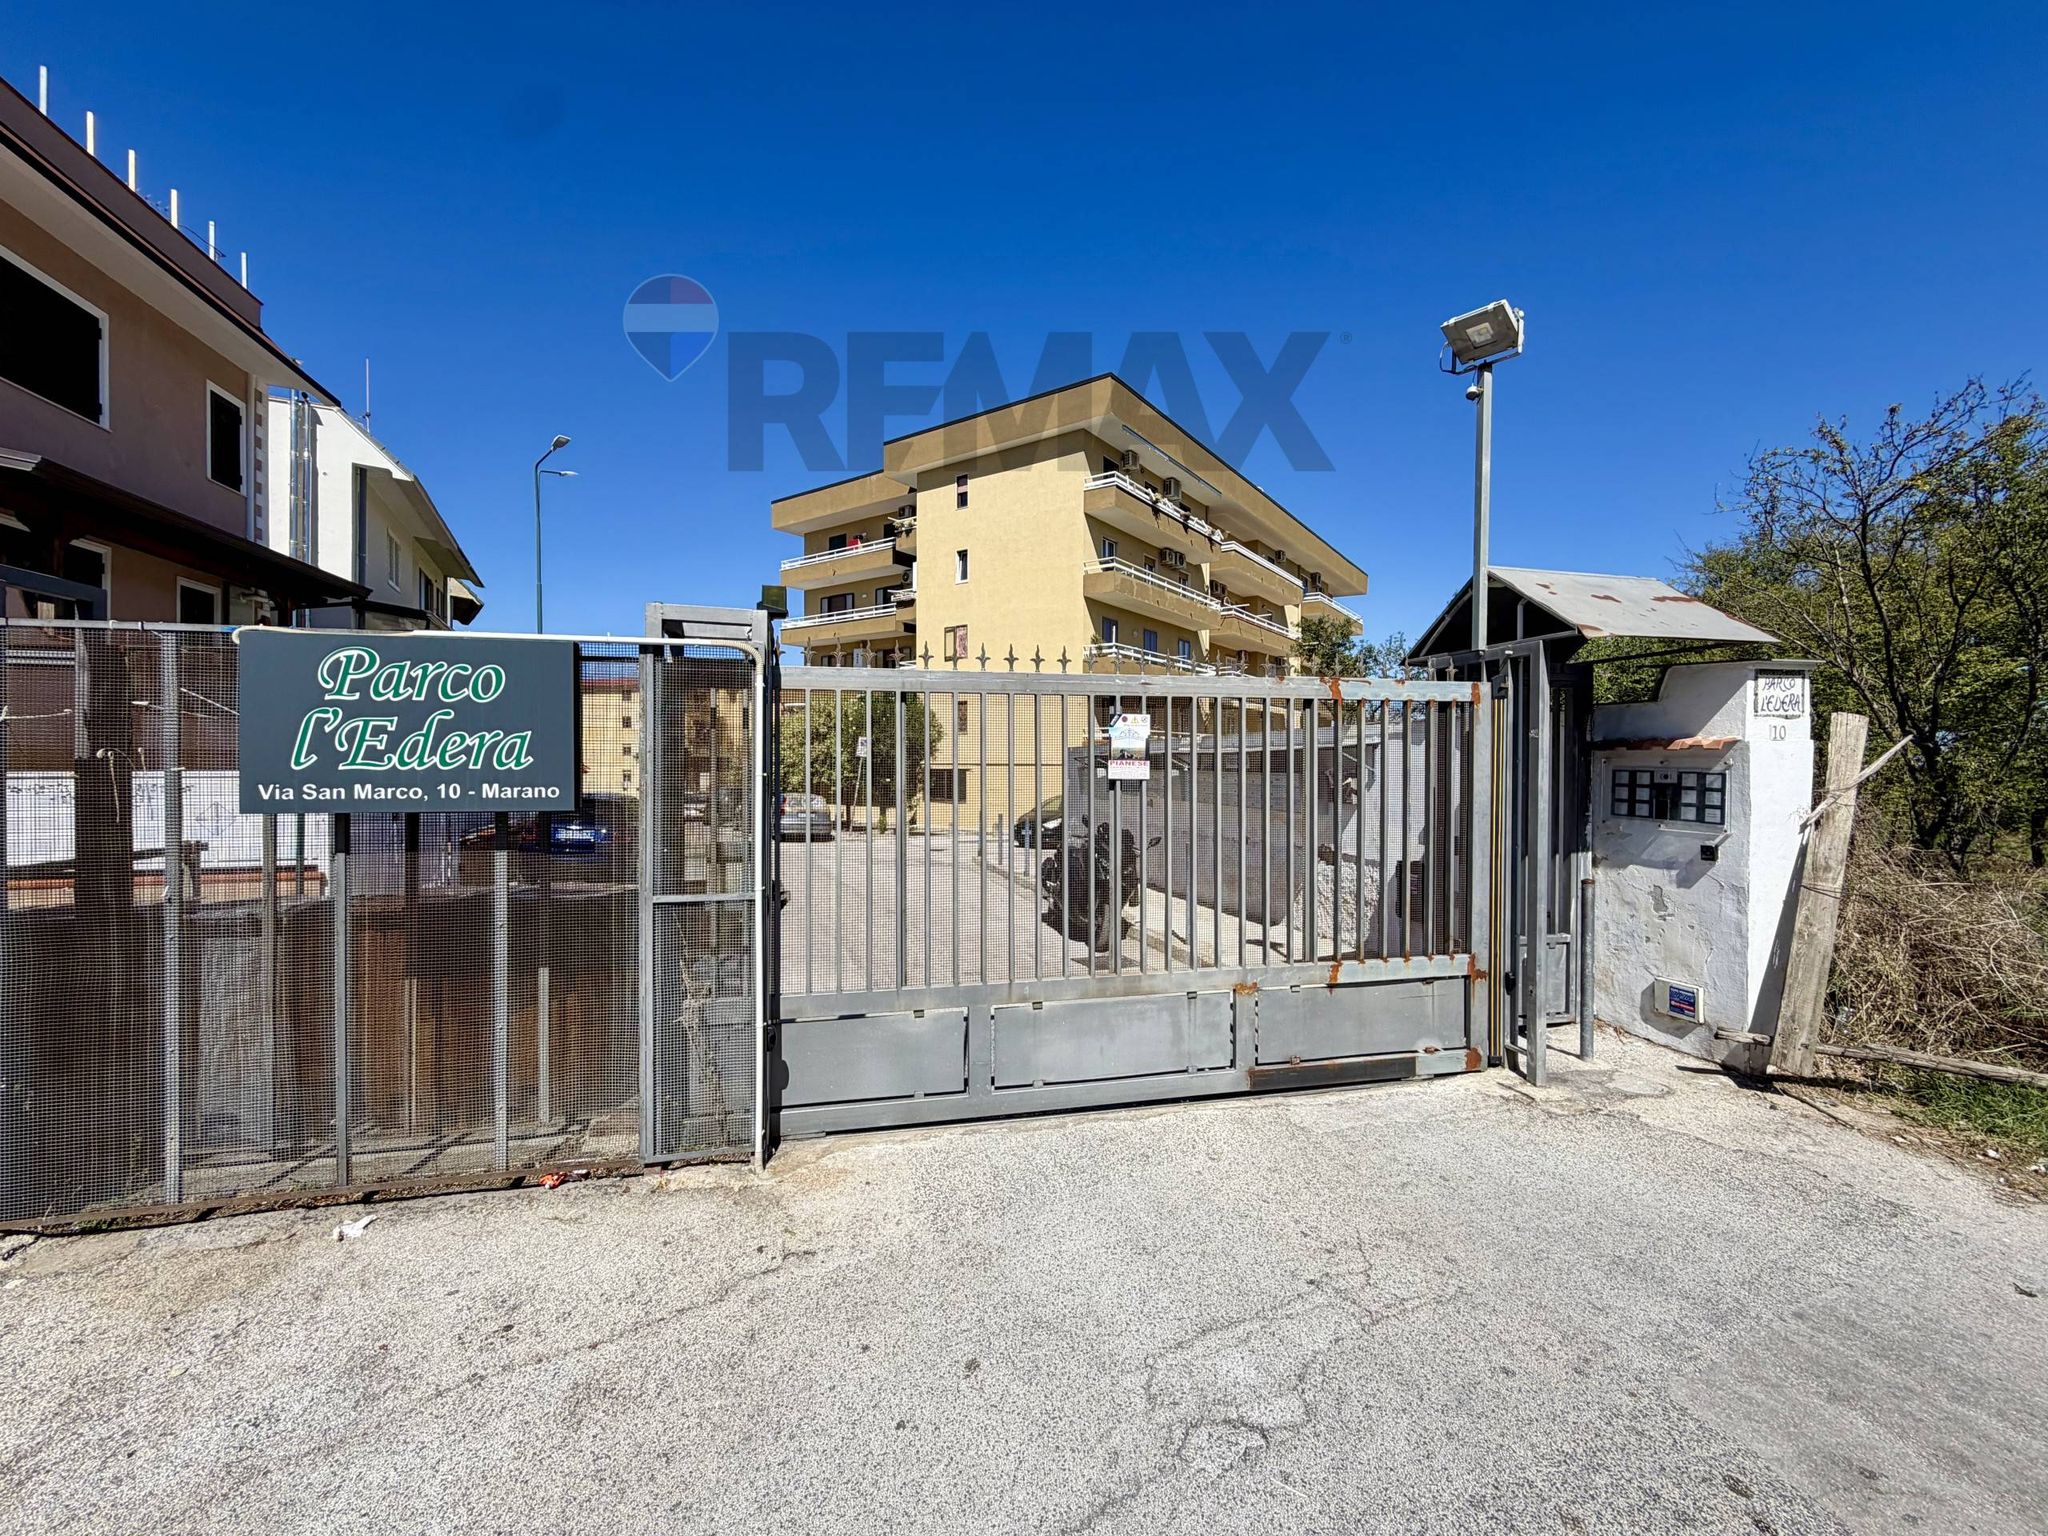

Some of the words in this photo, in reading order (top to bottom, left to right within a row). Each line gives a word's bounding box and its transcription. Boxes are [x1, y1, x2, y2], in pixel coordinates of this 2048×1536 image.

[317, 646, 506, 702] Parco
[1769, 724, 1787, 740] 10
[258, 785, 294, 800] Via
[302, 783, 346, 800] San
[353, 783, 428, 802] Marco,
[437, 783, 461, 799] 10
[483, 782, 560, 799] Marano
